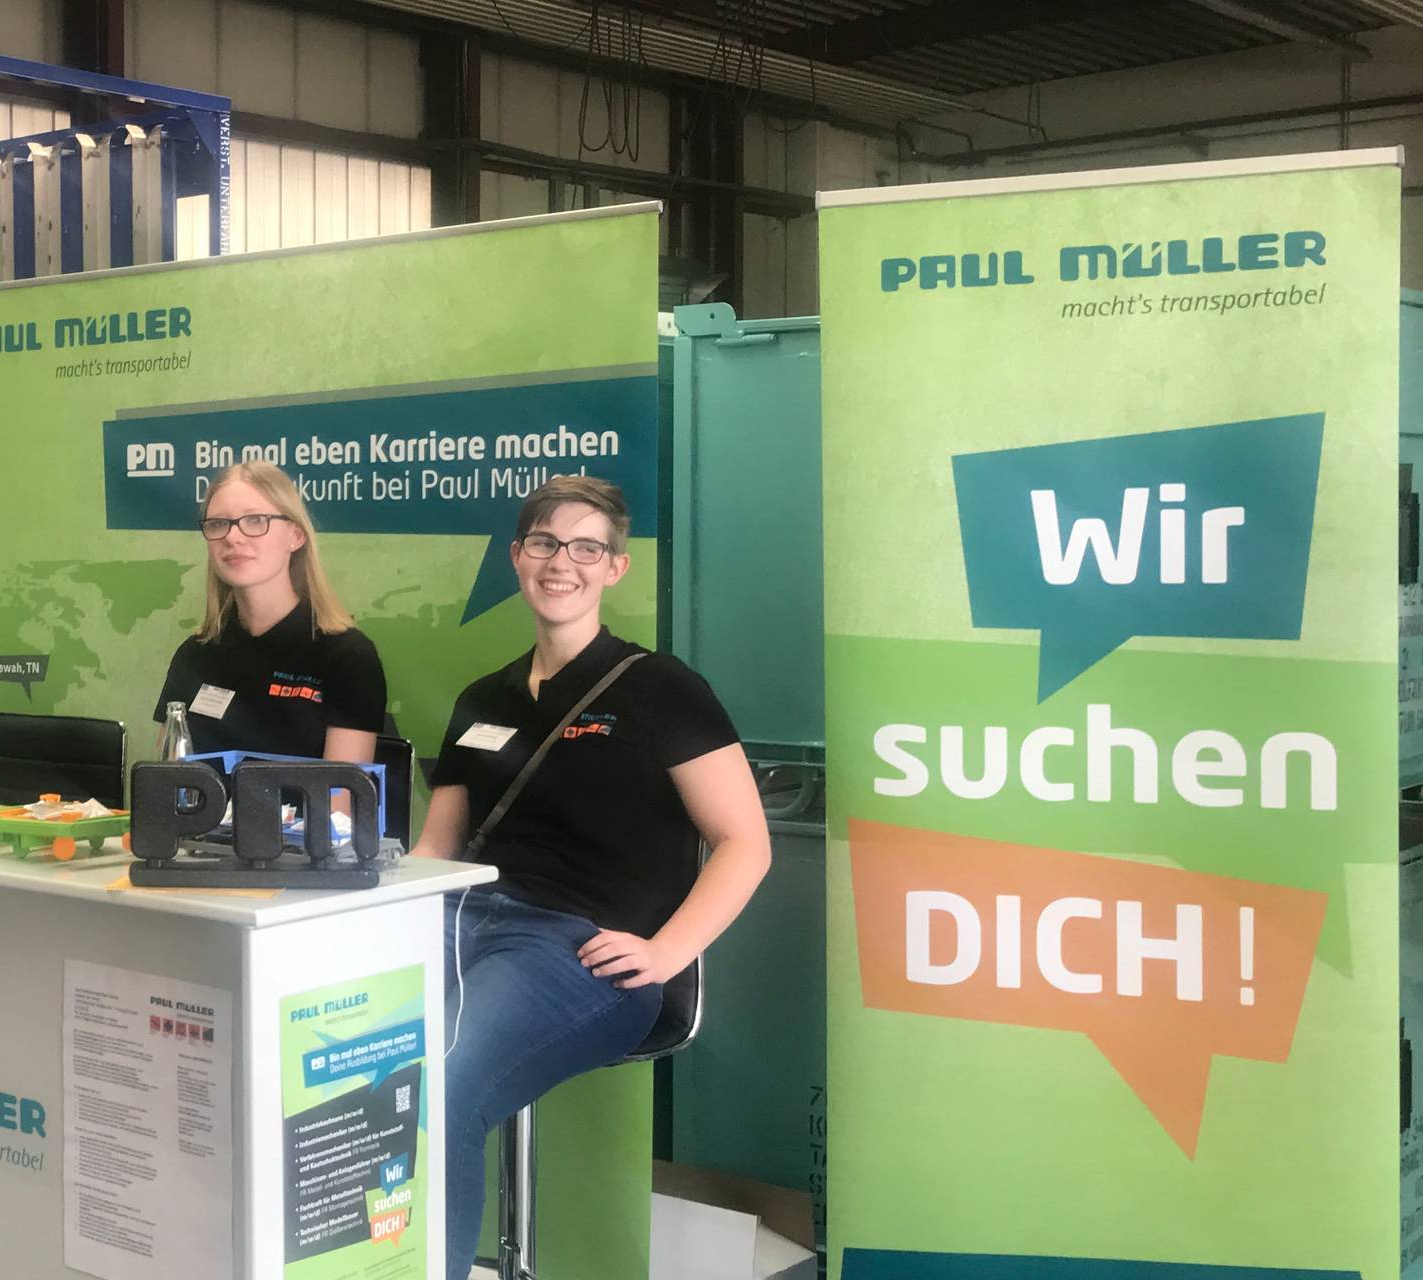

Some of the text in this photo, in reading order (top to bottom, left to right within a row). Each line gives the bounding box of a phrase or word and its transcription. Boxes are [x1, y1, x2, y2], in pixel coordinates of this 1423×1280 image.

[881, 231, 1327, 292] PAUL MÜLLER
[1061, 283, 1327, 319] macht's transportabel
[54, 306, 192, 348] MÜLLER
[55, 351, 192, 379] macht's transportabel
[195, 425, 619, 469] Bin mal eben Karriere machen
[372, 470, 410, 501] bei
[422, 468, 479, 500] Paul
[1030, 483, 1246, 585] Wir
[873, 703, 1338, 811] suchen
[290, 1005, 320, 1022] PAUL
[324, 992, 369, 1014] MÜLLER
[385, 1164, 403, 1183] Wir
[374, 1189, 412, 1213] suchen
